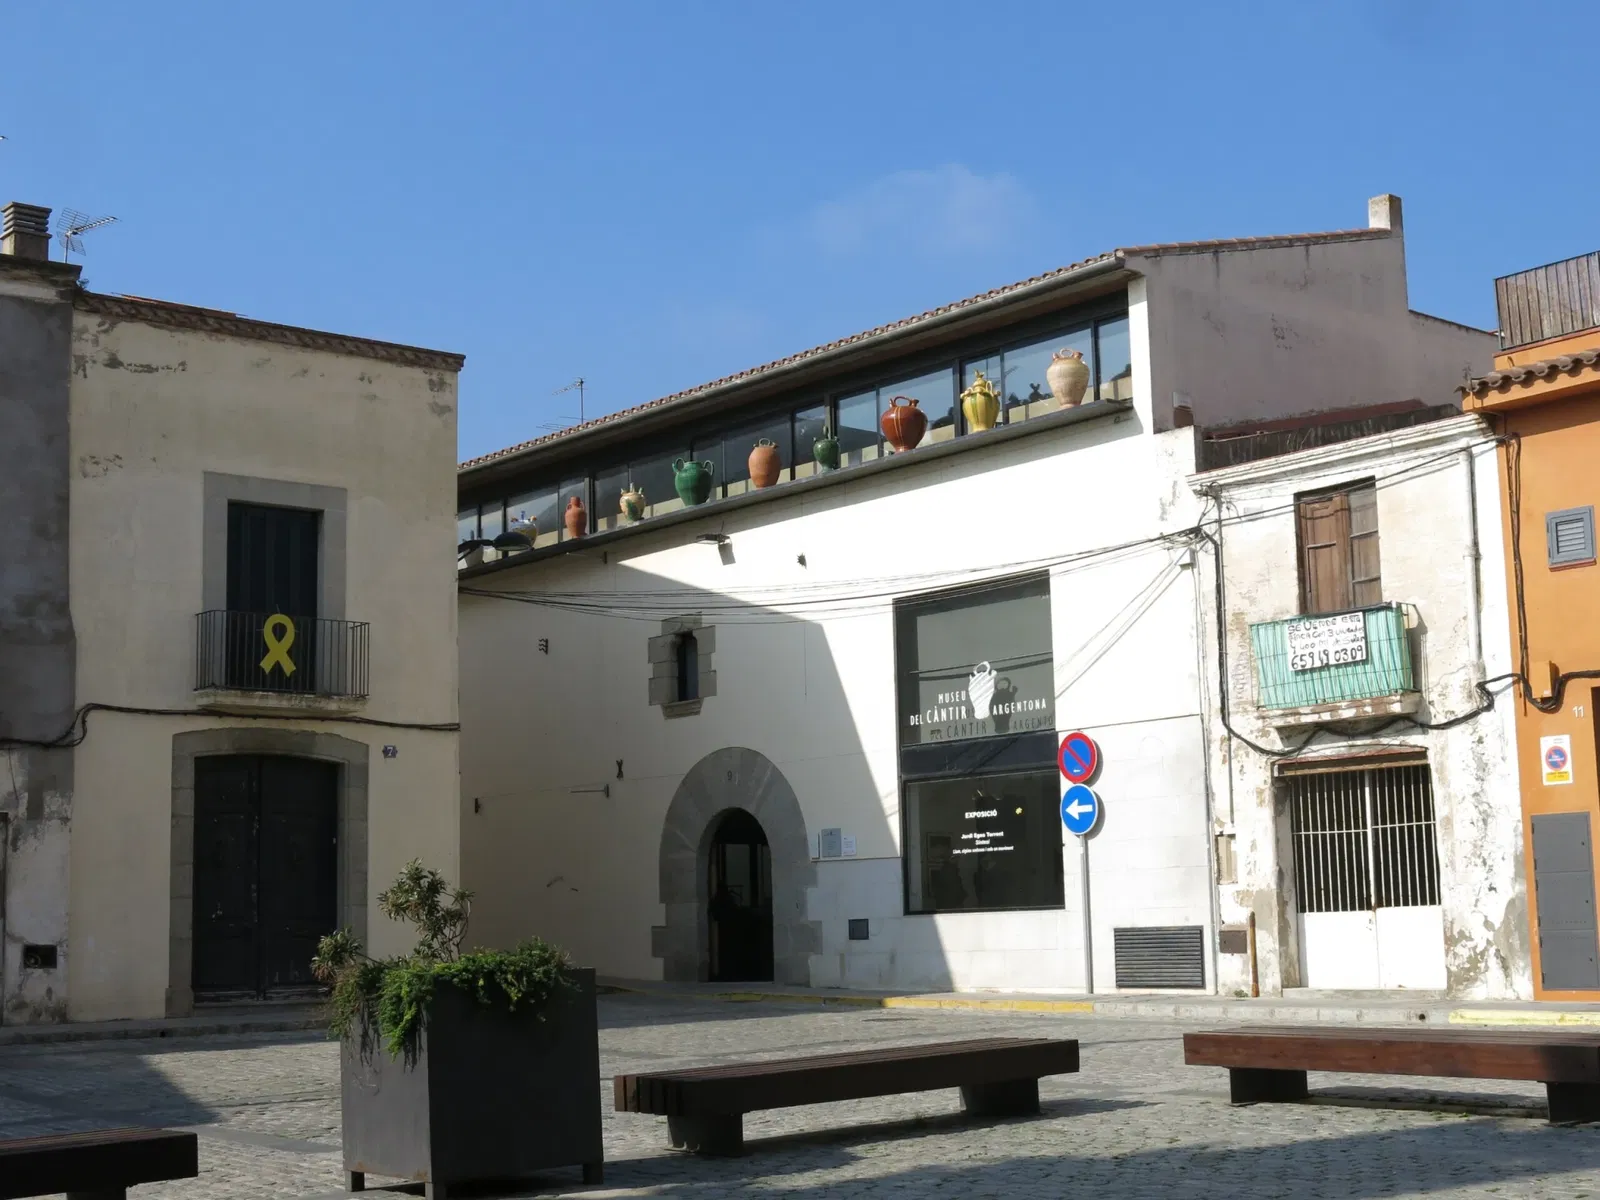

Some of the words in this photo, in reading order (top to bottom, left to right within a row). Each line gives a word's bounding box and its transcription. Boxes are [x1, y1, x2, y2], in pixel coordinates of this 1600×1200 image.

[1288, 624, 1301, 633] SE
[1291, 652, 1314, 669] 659
[1334, 645, 1364, 662] 0309
[938, 690, 966, 704] MUSEU
[910, 714, 924, 726] DEL
[927, 706, 967, 723] CÀNTIR
[993, 698, 1046, 715] ARGENTONA
[1572, 705, 1584, 718] 11
[387, 746, 393, 756] 7
[965, 809, 997, 818] EXPOSICIÓ
